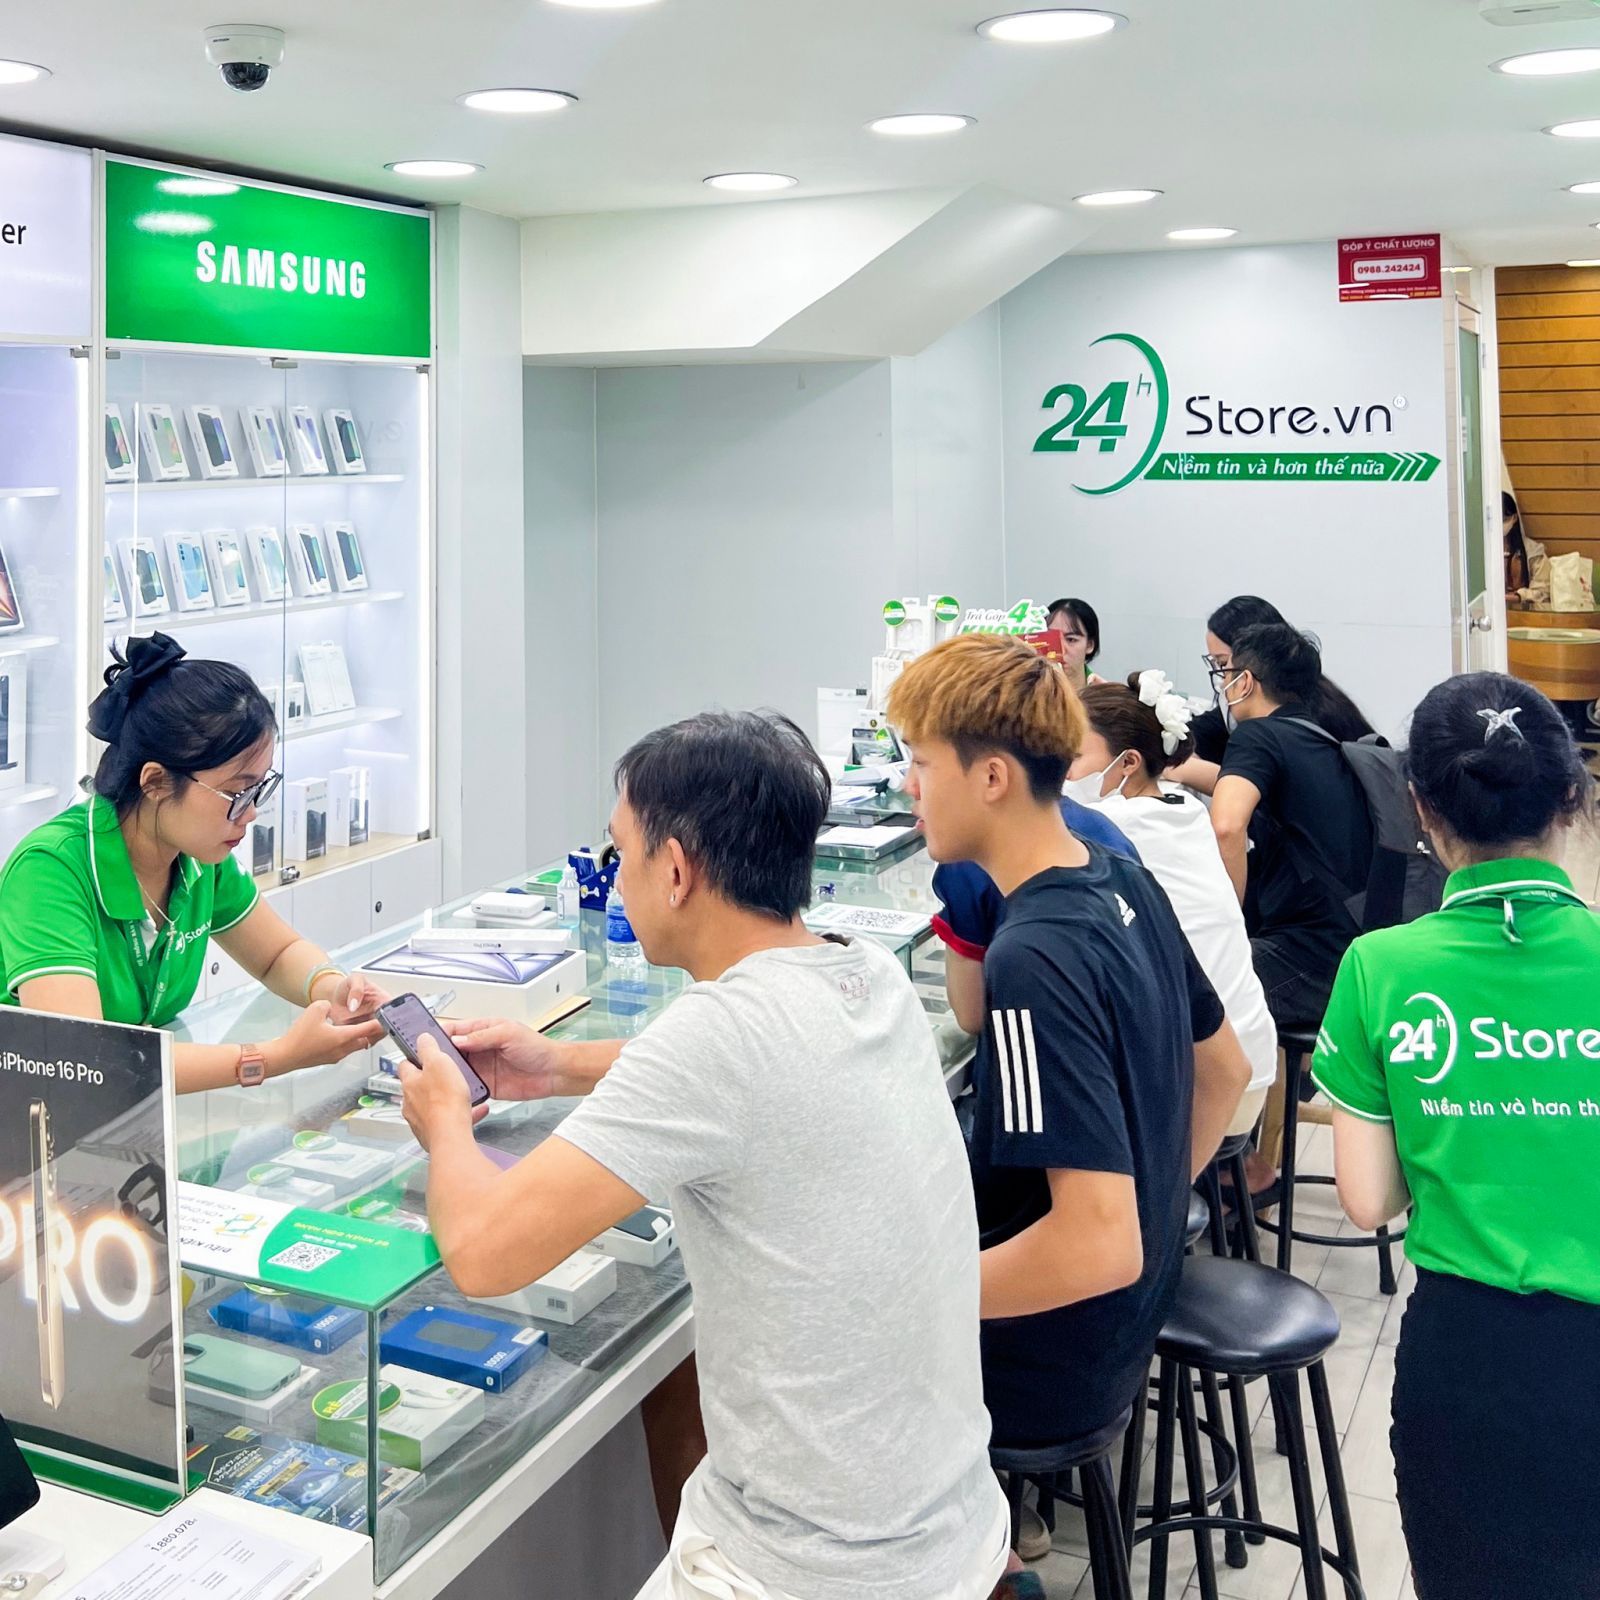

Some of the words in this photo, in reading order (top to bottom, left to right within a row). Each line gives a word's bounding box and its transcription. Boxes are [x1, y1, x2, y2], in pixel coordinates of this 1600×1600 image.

[1342, 242, 1363, 252] GÓP
[1365, 240, 1372, 250] Ý
[1374, 238, 1400, 250] CHẤT
[1402, 238, 1436, 249] LƯỢNG
[195, 240, 366, 299] SAMSUNG
[1357, 263, 1421, 274] 0988.242424
[1185, 395, 1392, 435] Store.vn
[1162, 455, 1210, 475] Niềm
[1216, 458, 1241, 475] tin
[1247, 458, 1267, 475] và
[1273, 460, 1307, 475] hơn
[1315, 455, 1350, 475] thế
[1351, 459, 1385, 475] nữa
[3, 1051, 56, 1077] iPhone
[56, 1060, 75, 1081] 16
[76, 1063, 104, 1085] Pro
[1420, 1096, 1463, 1116] Niềm
[1469, 1099, 1494, 1116] tin
[1500, 1097, 1526, 1116] và
[1531, 1098, 1571, 1116] hơn
